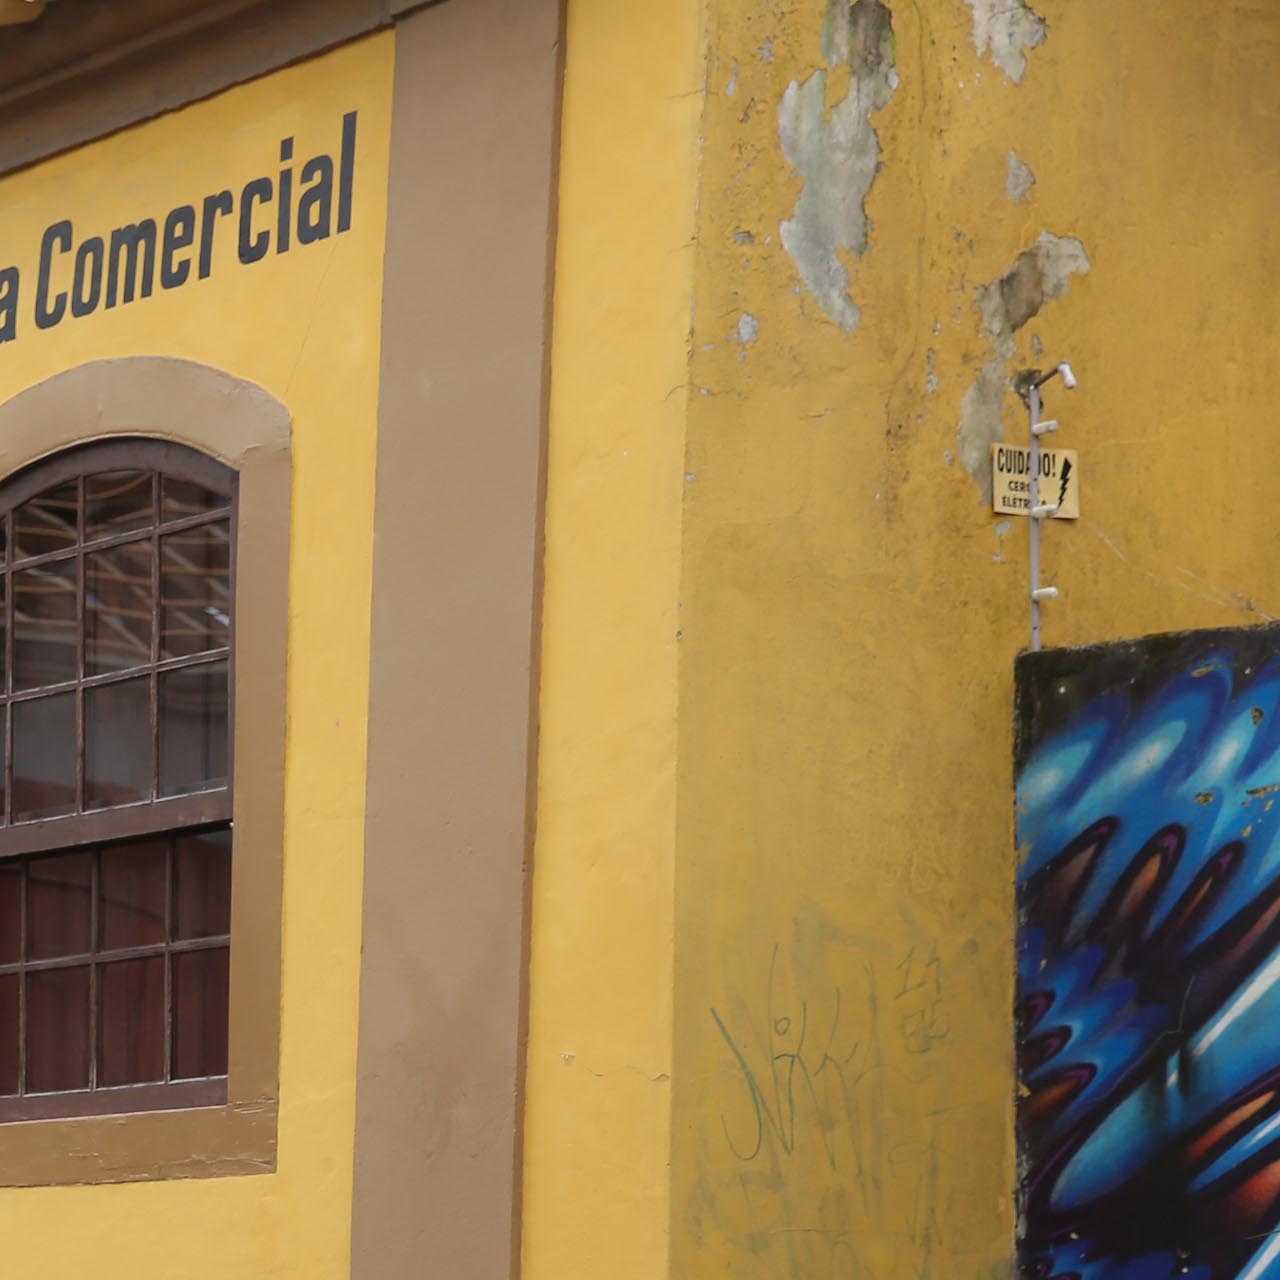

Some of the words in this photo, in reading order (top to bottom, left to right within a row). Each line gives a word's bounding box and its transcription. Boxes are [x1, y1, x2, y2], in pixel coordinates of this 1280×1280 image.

[34, 111, 358, 331] Comercial
[997, 447, 1056, 478] CUIDAO!
[1008, 480, 1041, 495] CERC
